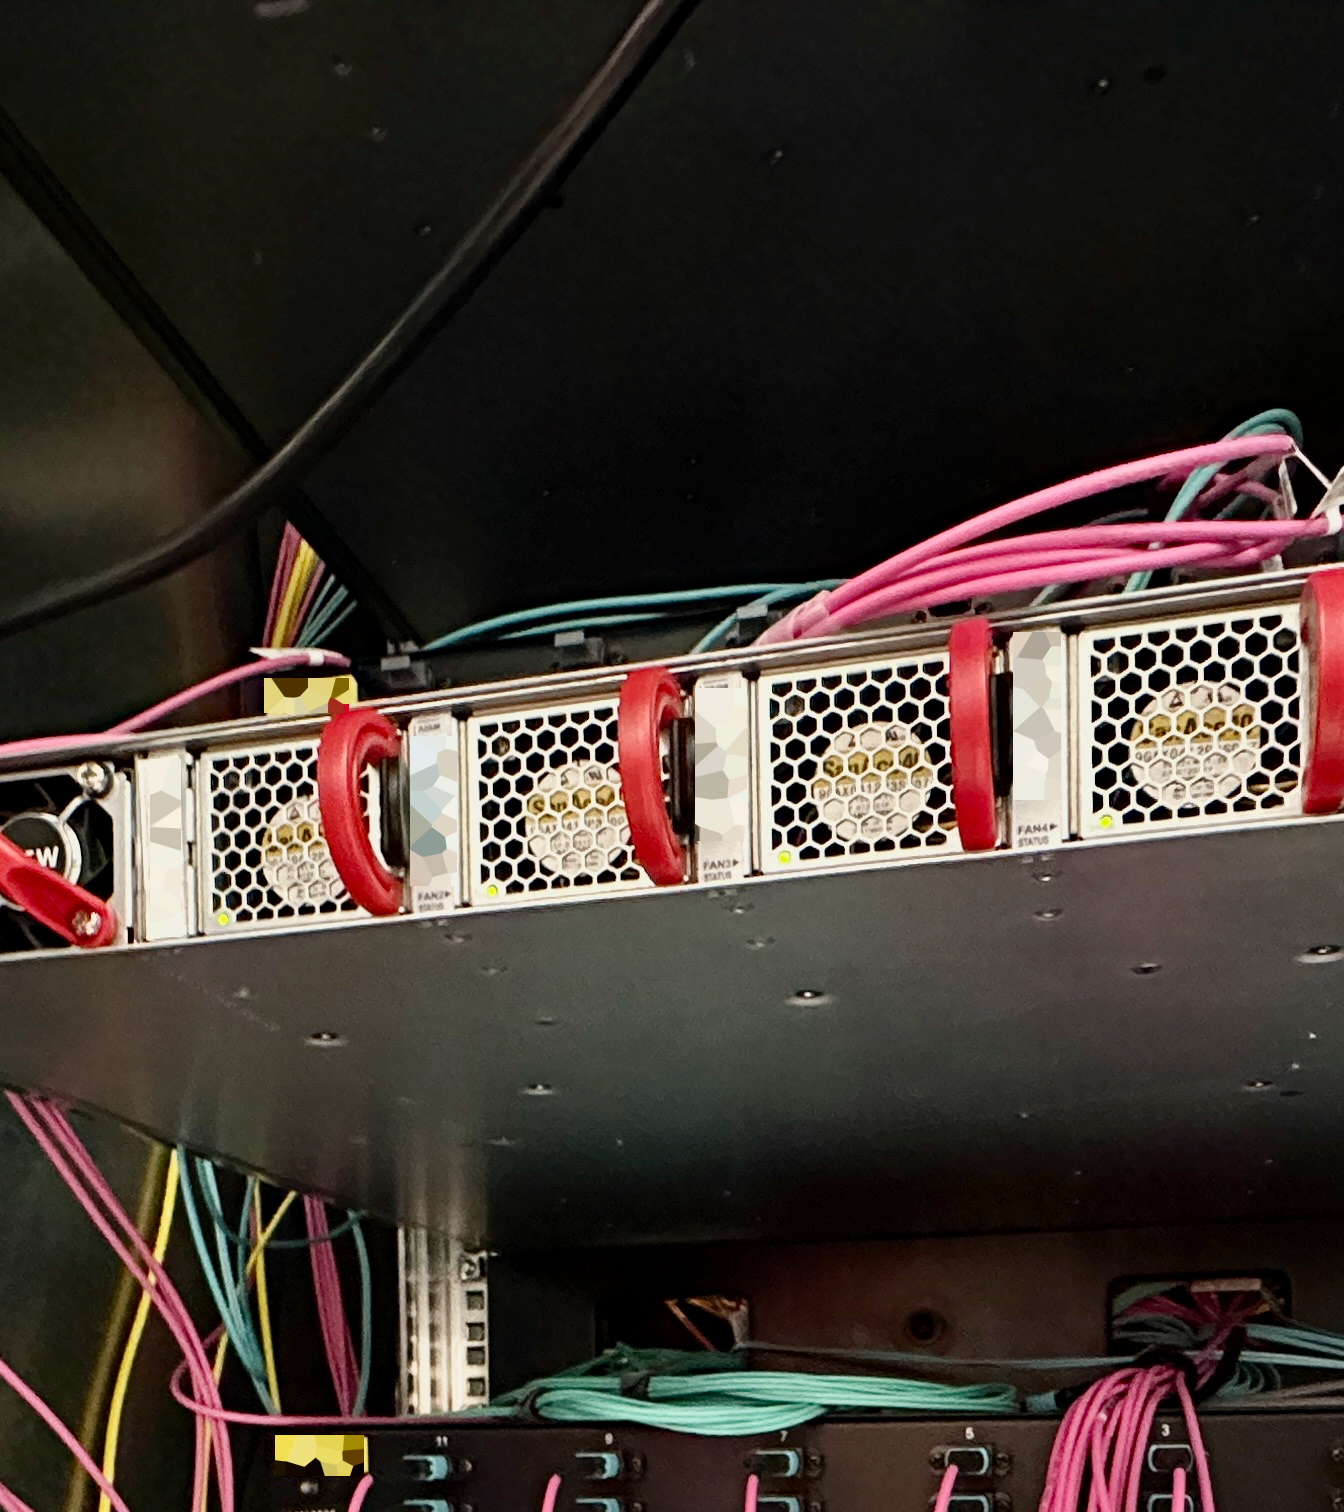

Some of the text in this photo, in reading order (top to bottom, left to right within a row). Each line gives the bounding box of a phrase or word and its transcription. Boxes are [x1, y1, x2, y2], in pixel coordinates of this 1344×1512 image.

[780, 1429, 789, 1442] 7
[965, 1427, 975, 1440] 5
[1161, 1424, 1171, 1437] 3
[435, 1435, 449, 1447] 11
[605, 1432, 614, 1445] 9
